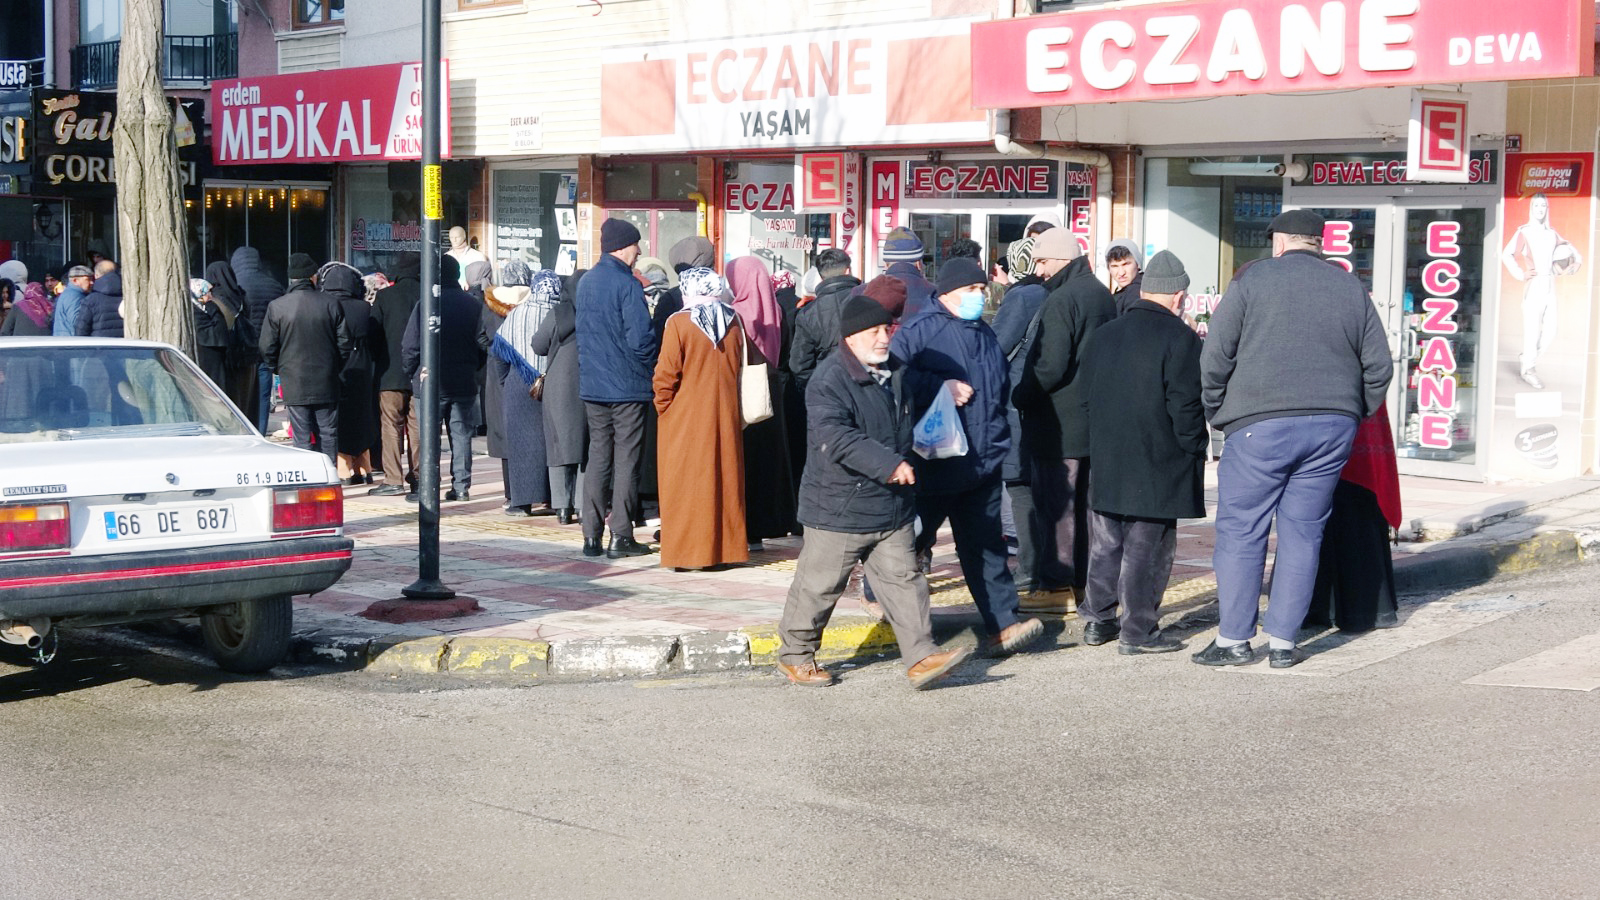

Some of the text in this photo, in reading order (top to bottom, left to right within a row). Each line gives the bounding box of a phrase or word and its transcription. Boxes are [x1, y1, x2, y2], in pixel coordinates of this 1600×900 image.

[1026, 0, 1417, 94] ECZANE
[1447, 32, 1542, 66] DEVA
[687, 38, 873, 104] ECZANE
[222, 82, 261, 107] erdem
[219, 89, 381, 161] MEDİKAL
[740, 109, 811, 140] YAŞAM
[913, 166, 1050, 193] ECZANE
[1313, 161, 1366, 185] DEVA
[1525, 178, 1551, 189] enerji
[1528, 166, 1572, 179] Gün boyu
[725, 182, 795, 213] ECZA
[764, 218, 796, 234] YAŞAM
[1418, 221, 1461, 449] ECZANE
[237, 472, 250, 485] 86
[255, 472, 271, 484] 1.9
[117, 508, 229, 536] 66 DE 687
